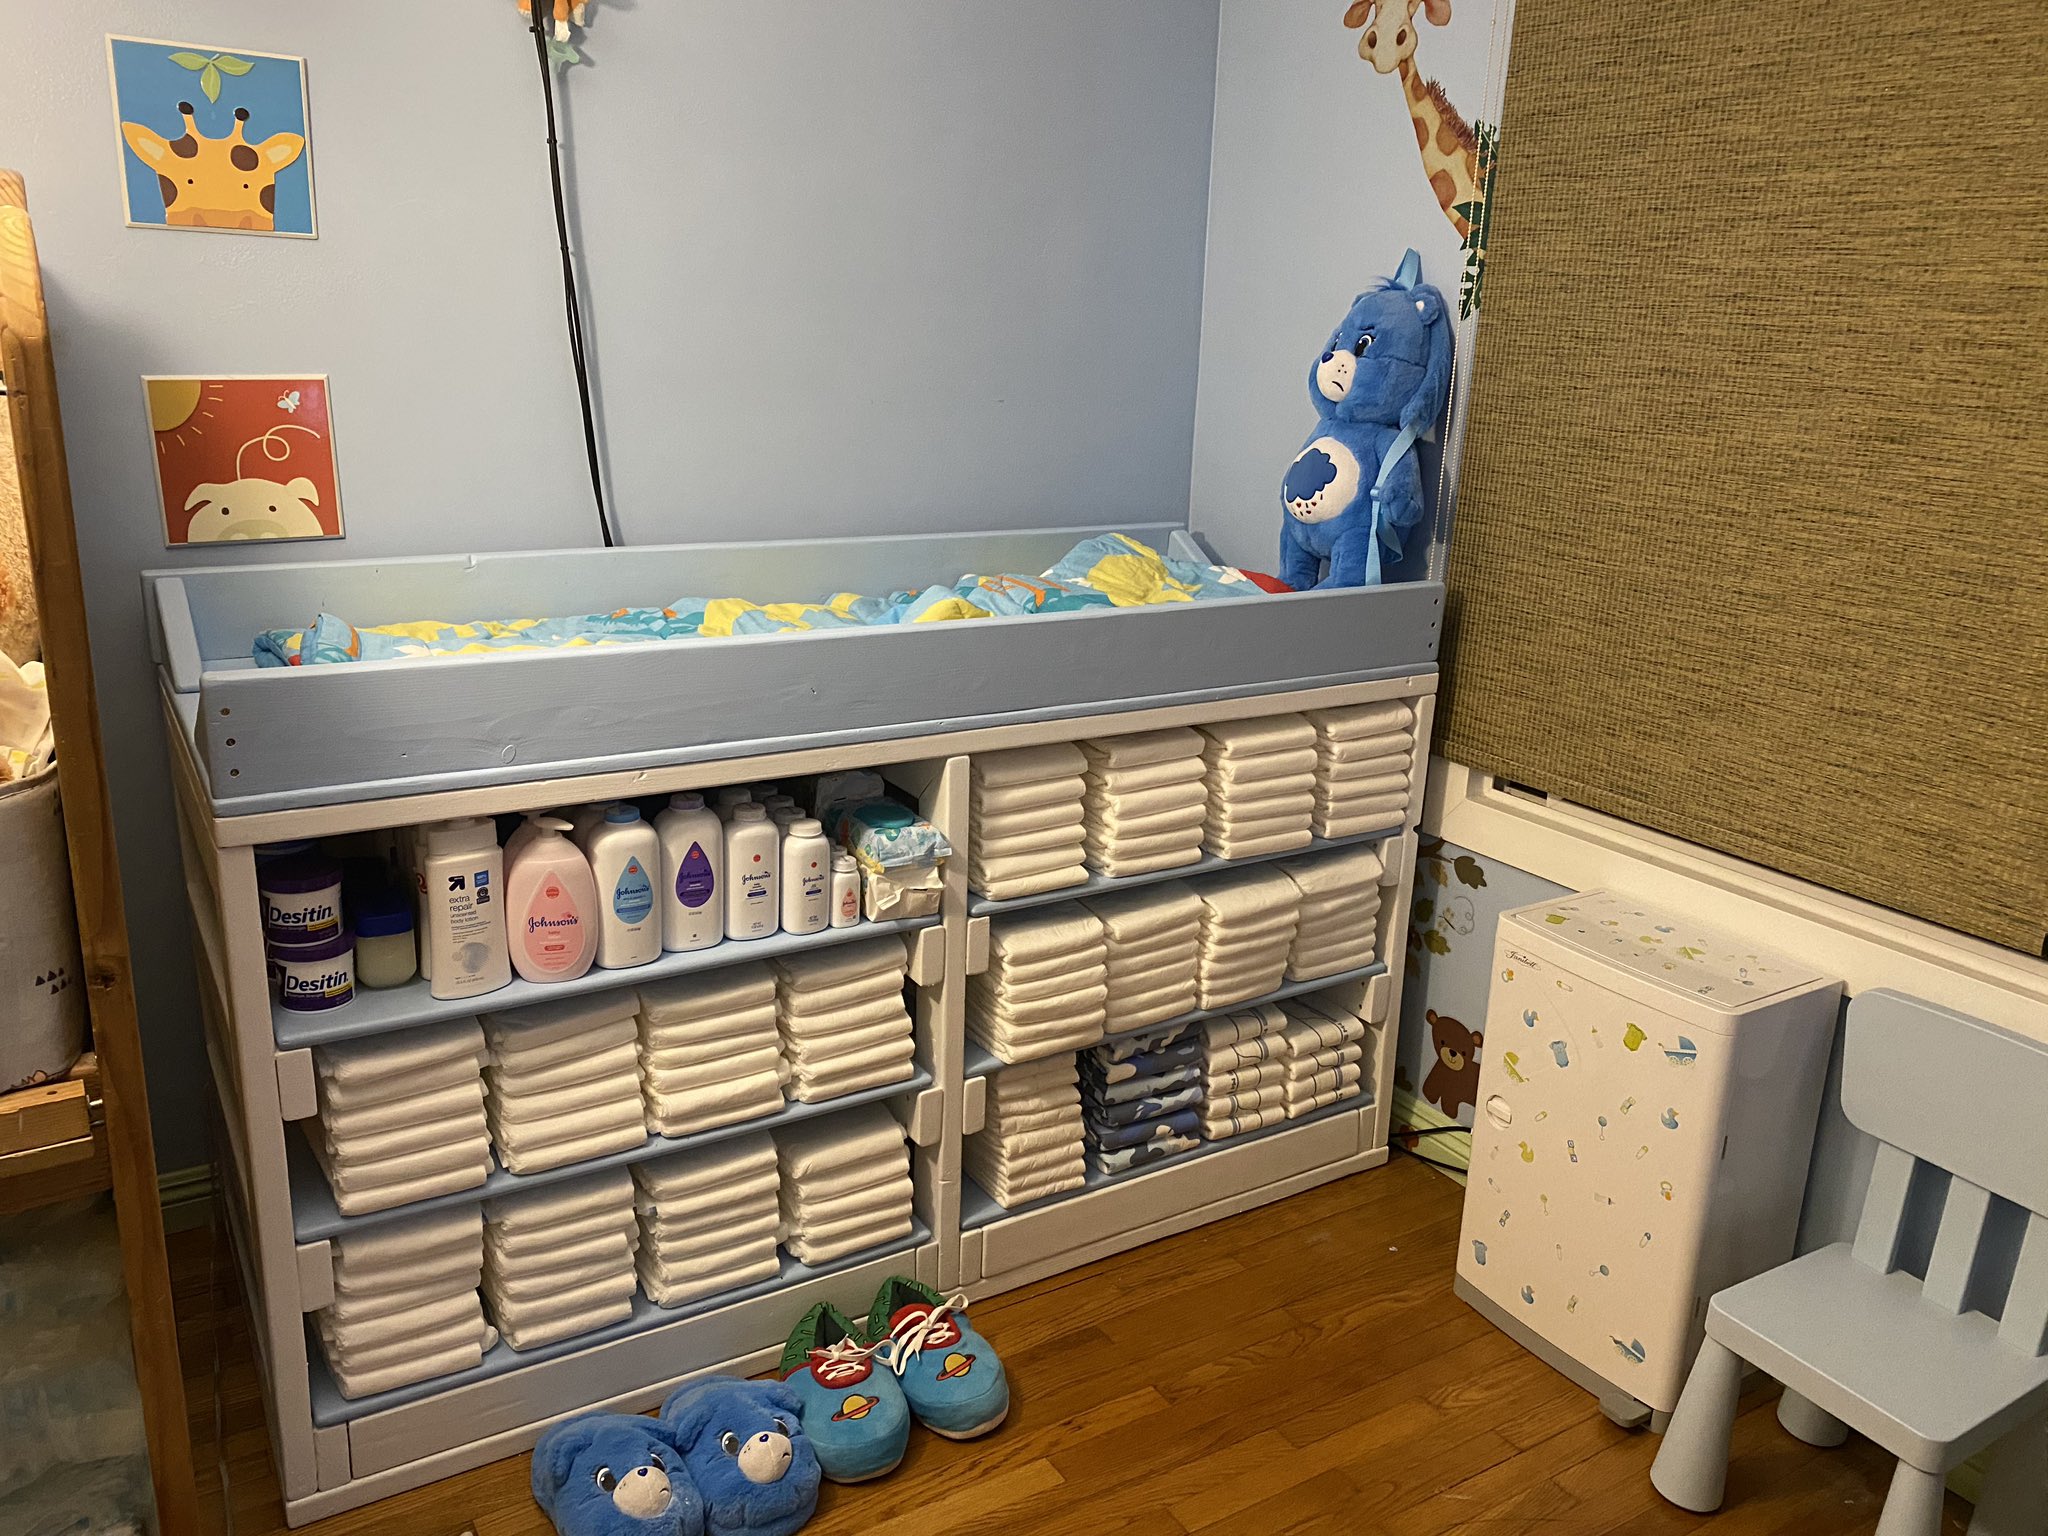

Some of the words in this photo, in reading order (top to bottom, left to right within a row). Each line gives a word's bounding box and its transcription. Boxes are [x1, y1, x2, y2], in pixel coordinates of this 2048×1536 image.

[449, 895, 470, 904] extra
[450, 903, 473, 913] repair
[270, 904, 332, 924] Desitin
[528, 915, 578, 934] Johnson's
[286, 971, 347, 992] Desitin
